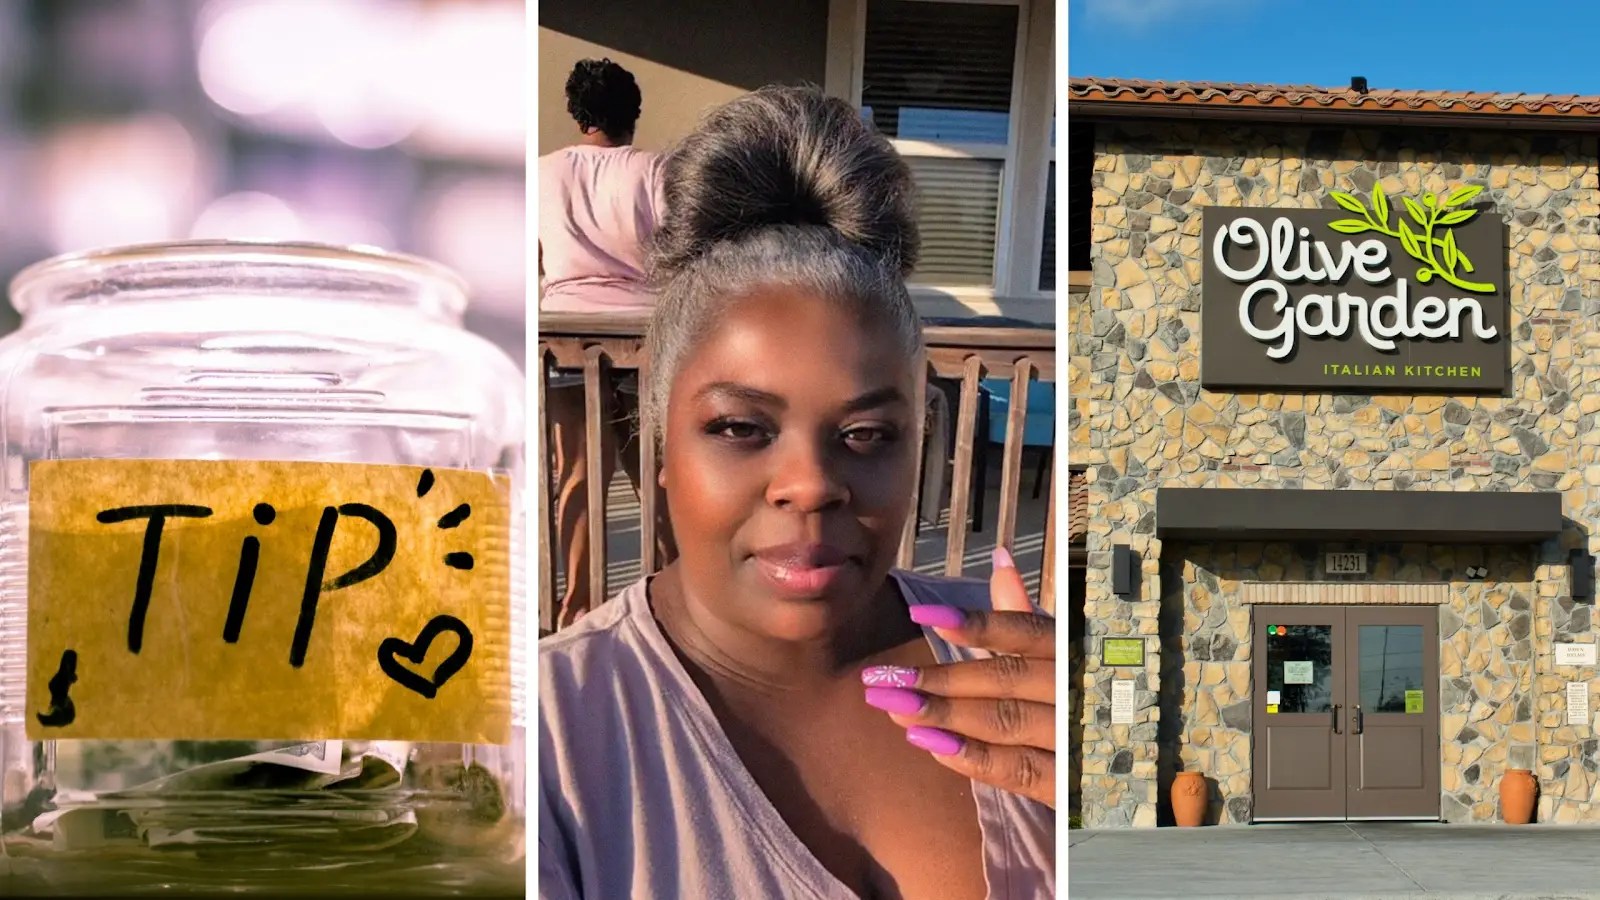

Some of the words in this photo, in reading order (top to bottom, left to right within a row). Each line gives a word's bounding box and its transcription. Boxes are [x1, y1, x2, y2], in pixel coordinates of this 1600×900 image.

[1213, 217, 1391, 283] Olive
[1239, 278, 1498, 359] Garden
[1323, 364, 1396, 376] ITALIAN
[1404, 365, 1481, 377] KITCHEN
